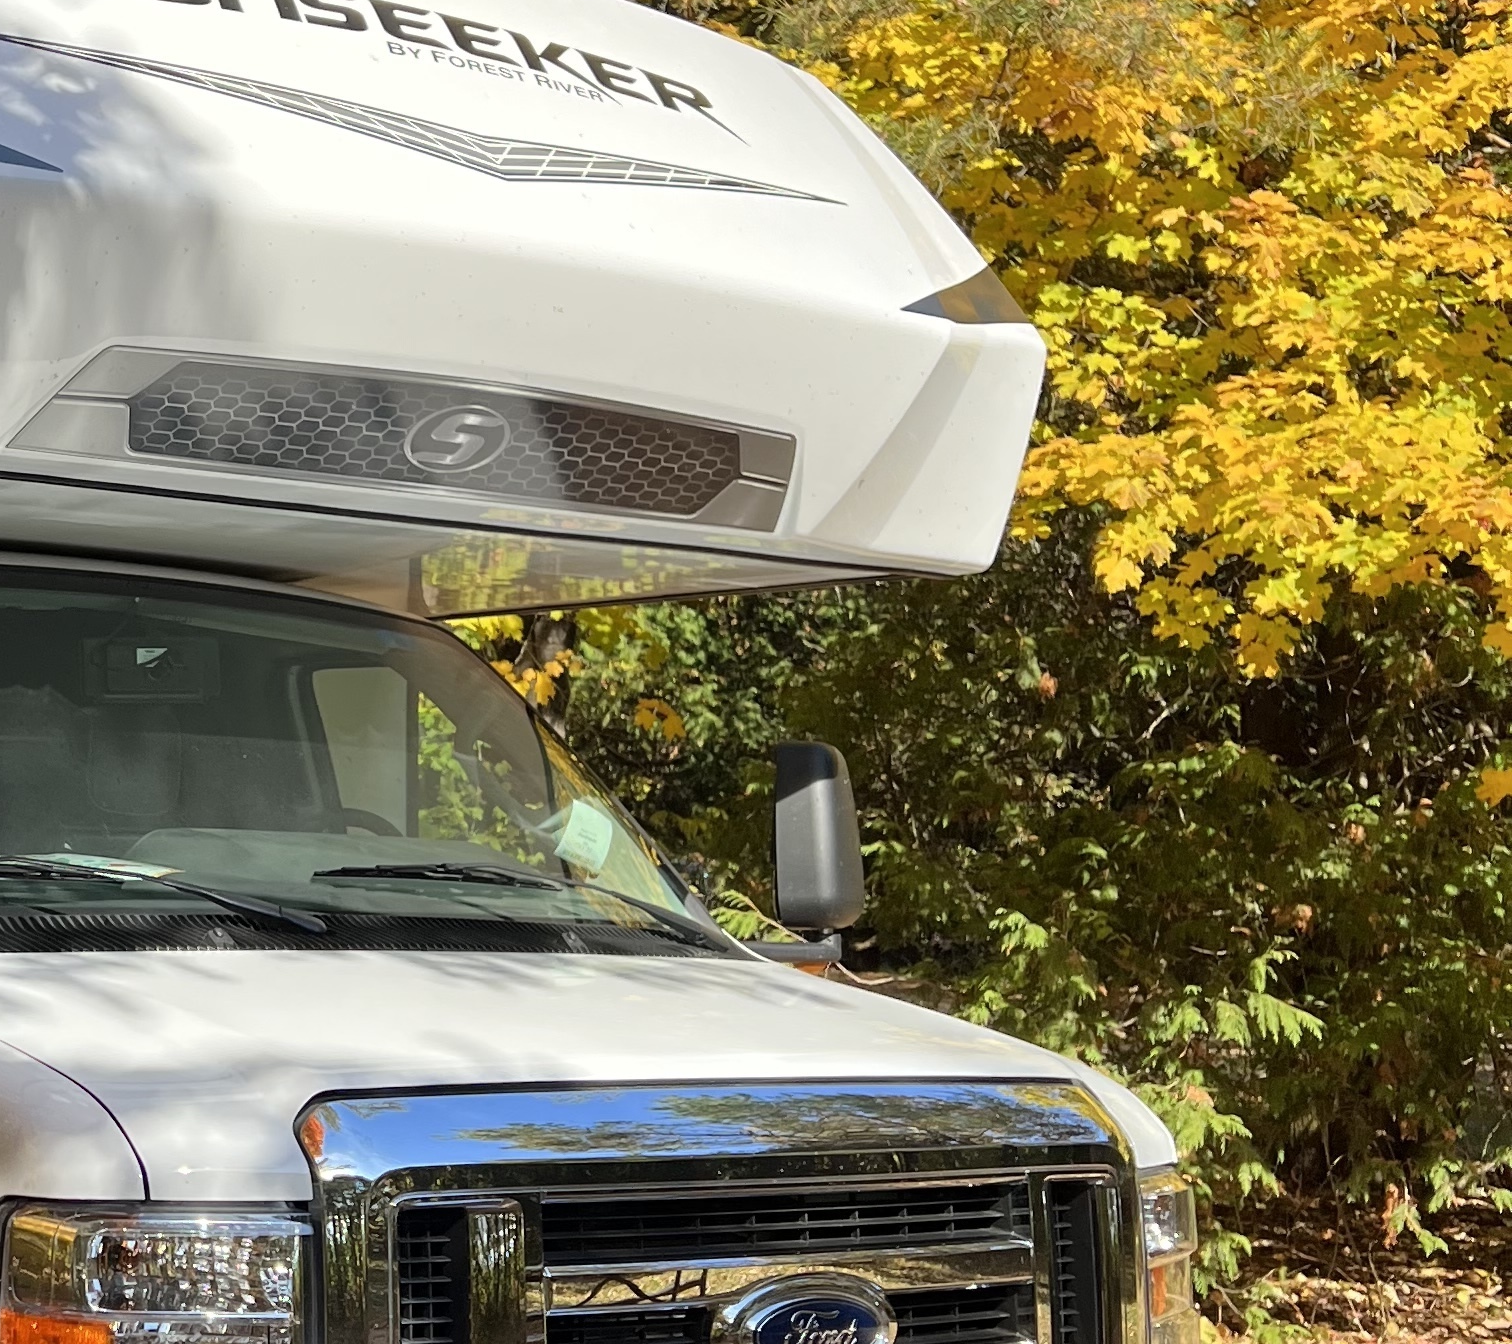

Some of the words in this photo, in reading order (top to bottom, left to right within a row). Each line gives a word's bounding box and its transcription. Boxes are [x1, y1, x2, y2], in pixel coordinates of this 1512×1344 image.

[386, 40, 422, 60] BY
[430, 49, 526, 83] FOREST
[533, 73, 605, 103] RIVER
